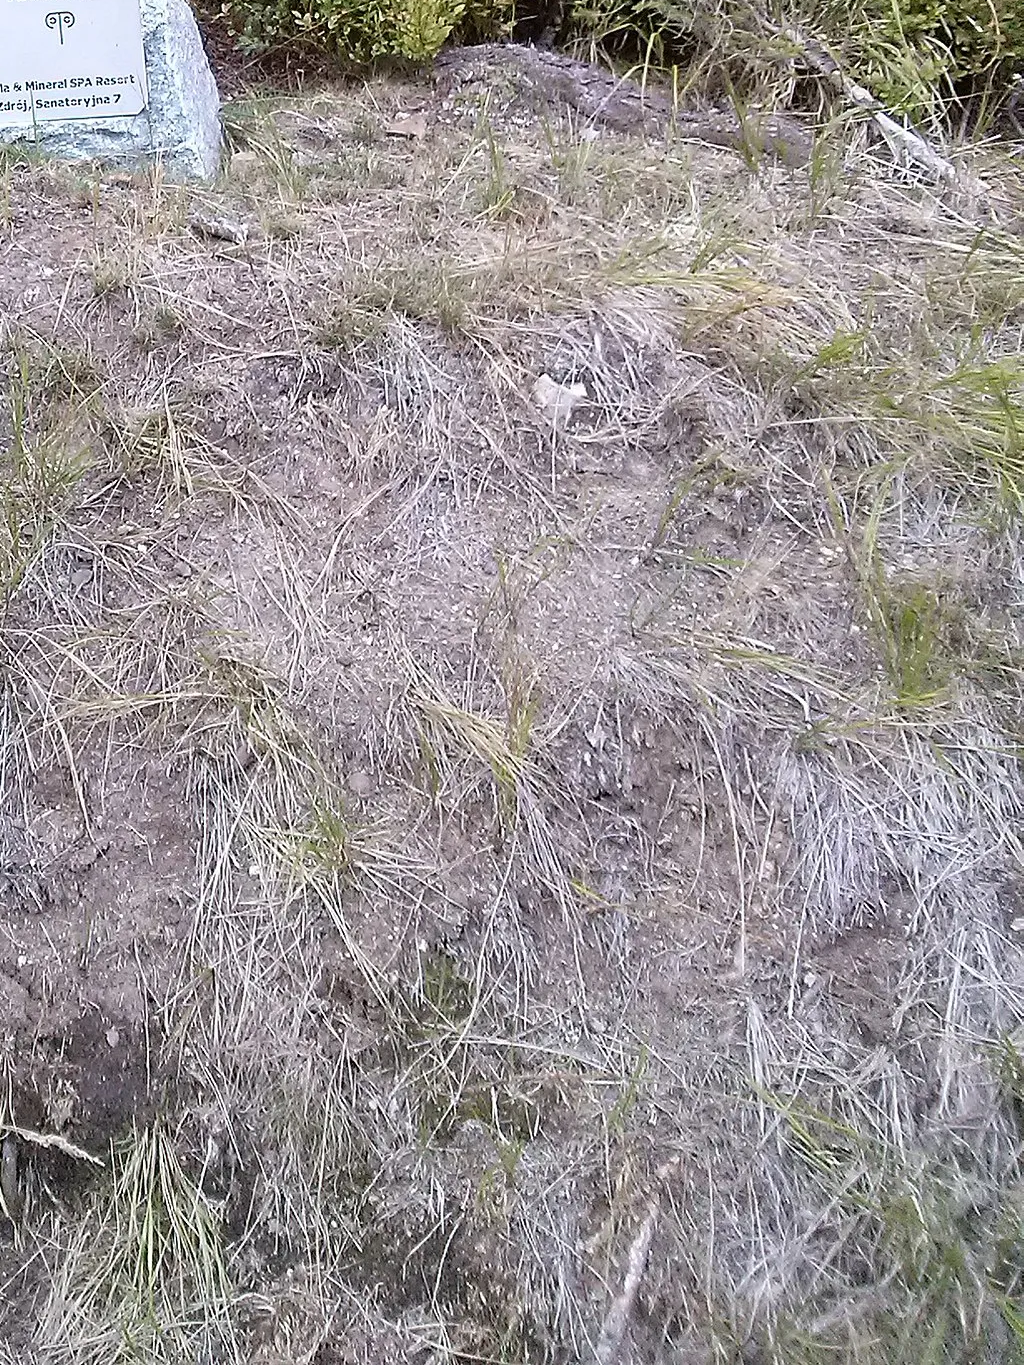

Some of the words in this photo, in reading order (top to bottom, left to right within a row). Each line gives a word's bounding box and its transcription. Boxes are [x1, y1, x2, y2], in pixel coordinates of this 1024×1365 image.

[13, 82, 22, 92] &
[26, 79, 67, 91] Mineral
[69, 77, 92, 88] SPA
[96, 74, 135, 86] Resort
[35, 95, 110, 110] Sanatoryjna
[113, 94, 121, 104] 7
